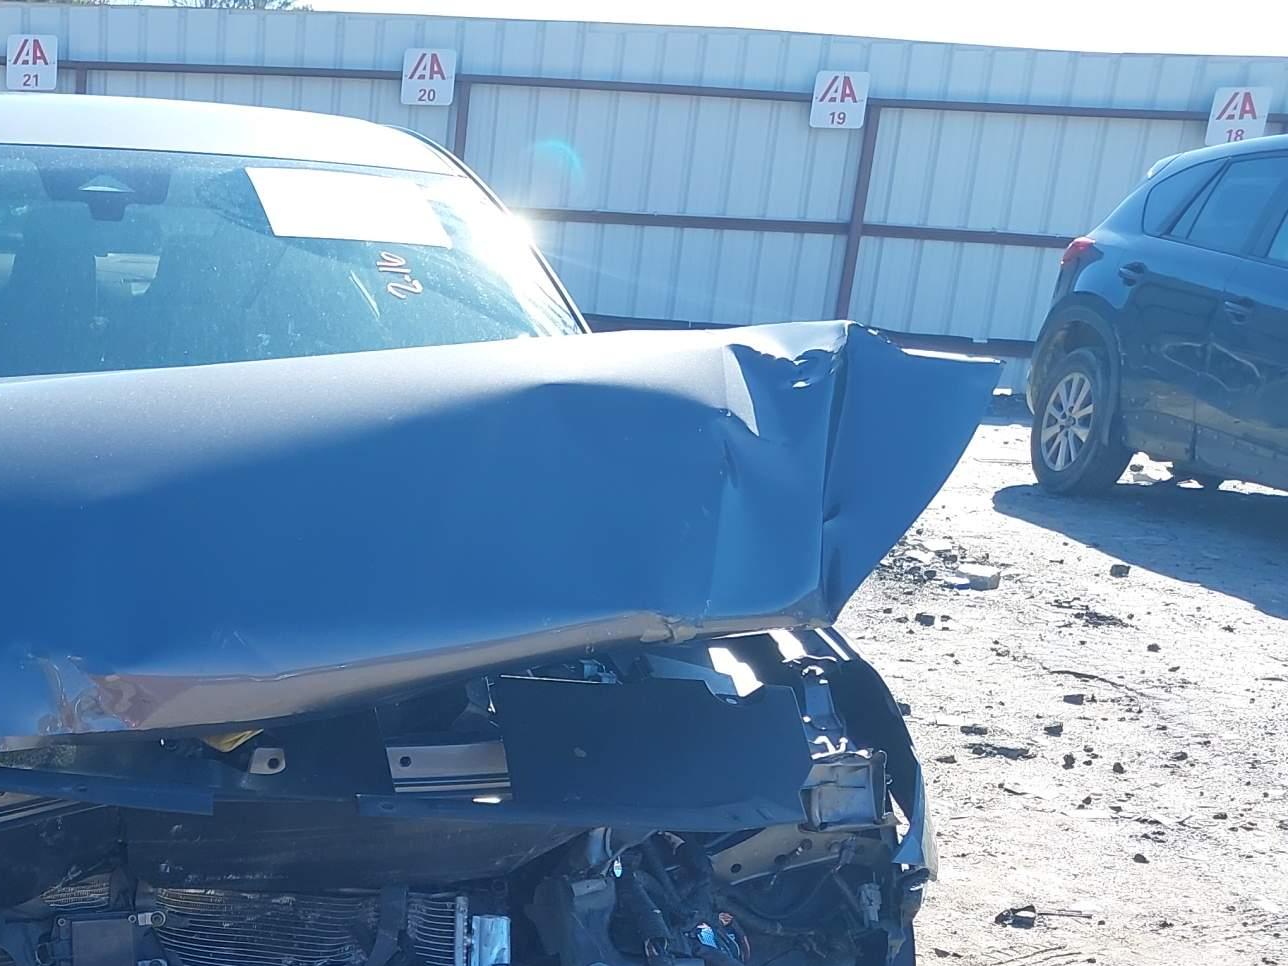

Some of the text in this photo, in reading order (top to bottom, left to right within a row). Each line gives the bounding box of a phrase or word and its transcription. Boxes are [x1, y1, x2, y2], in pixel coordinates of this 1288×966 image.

[23, 73, 39, 87] 21
[417, 88, 436, 102] 20
[829, 111, 846, 125] 19
[1225, 128, 1245, 143] 18
